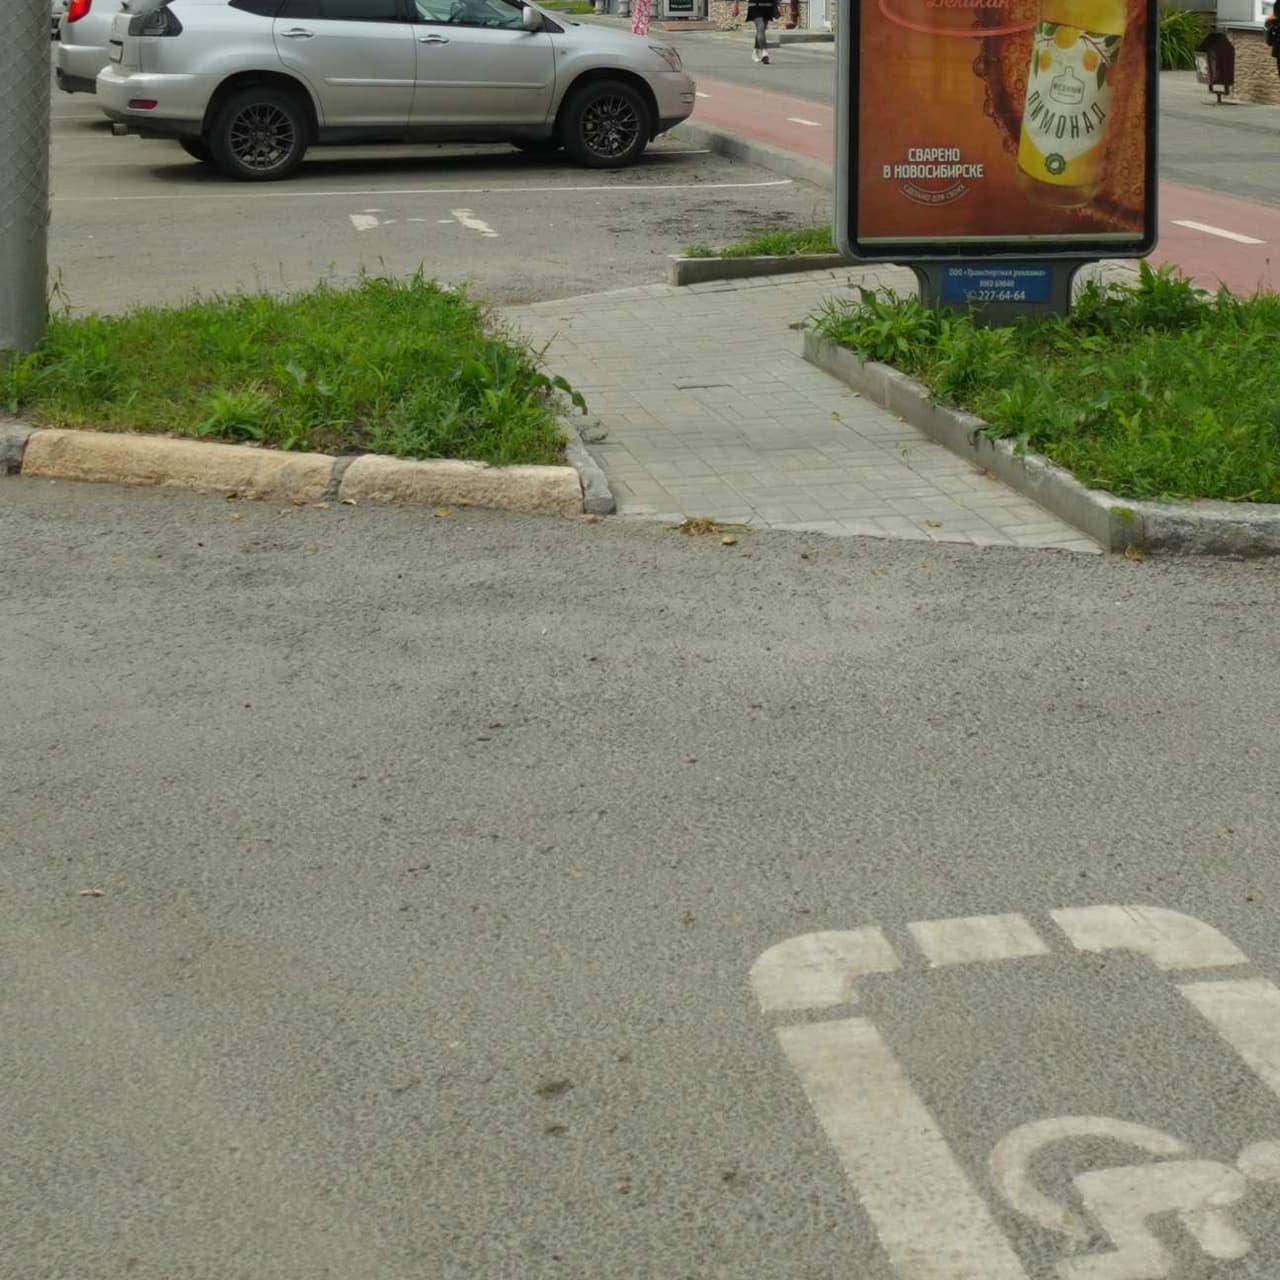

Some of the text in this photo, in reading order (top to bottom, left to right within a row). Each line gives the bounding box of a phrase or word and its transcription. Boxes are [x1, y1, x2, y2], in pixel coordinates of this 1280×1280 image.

[1028, 90, 1106, 139] ЛИМОНАД
[908, 147, 960, 162] СВАРЕНО
[883, 164, 984, 178] В НОВОСИБИРСКЕ
